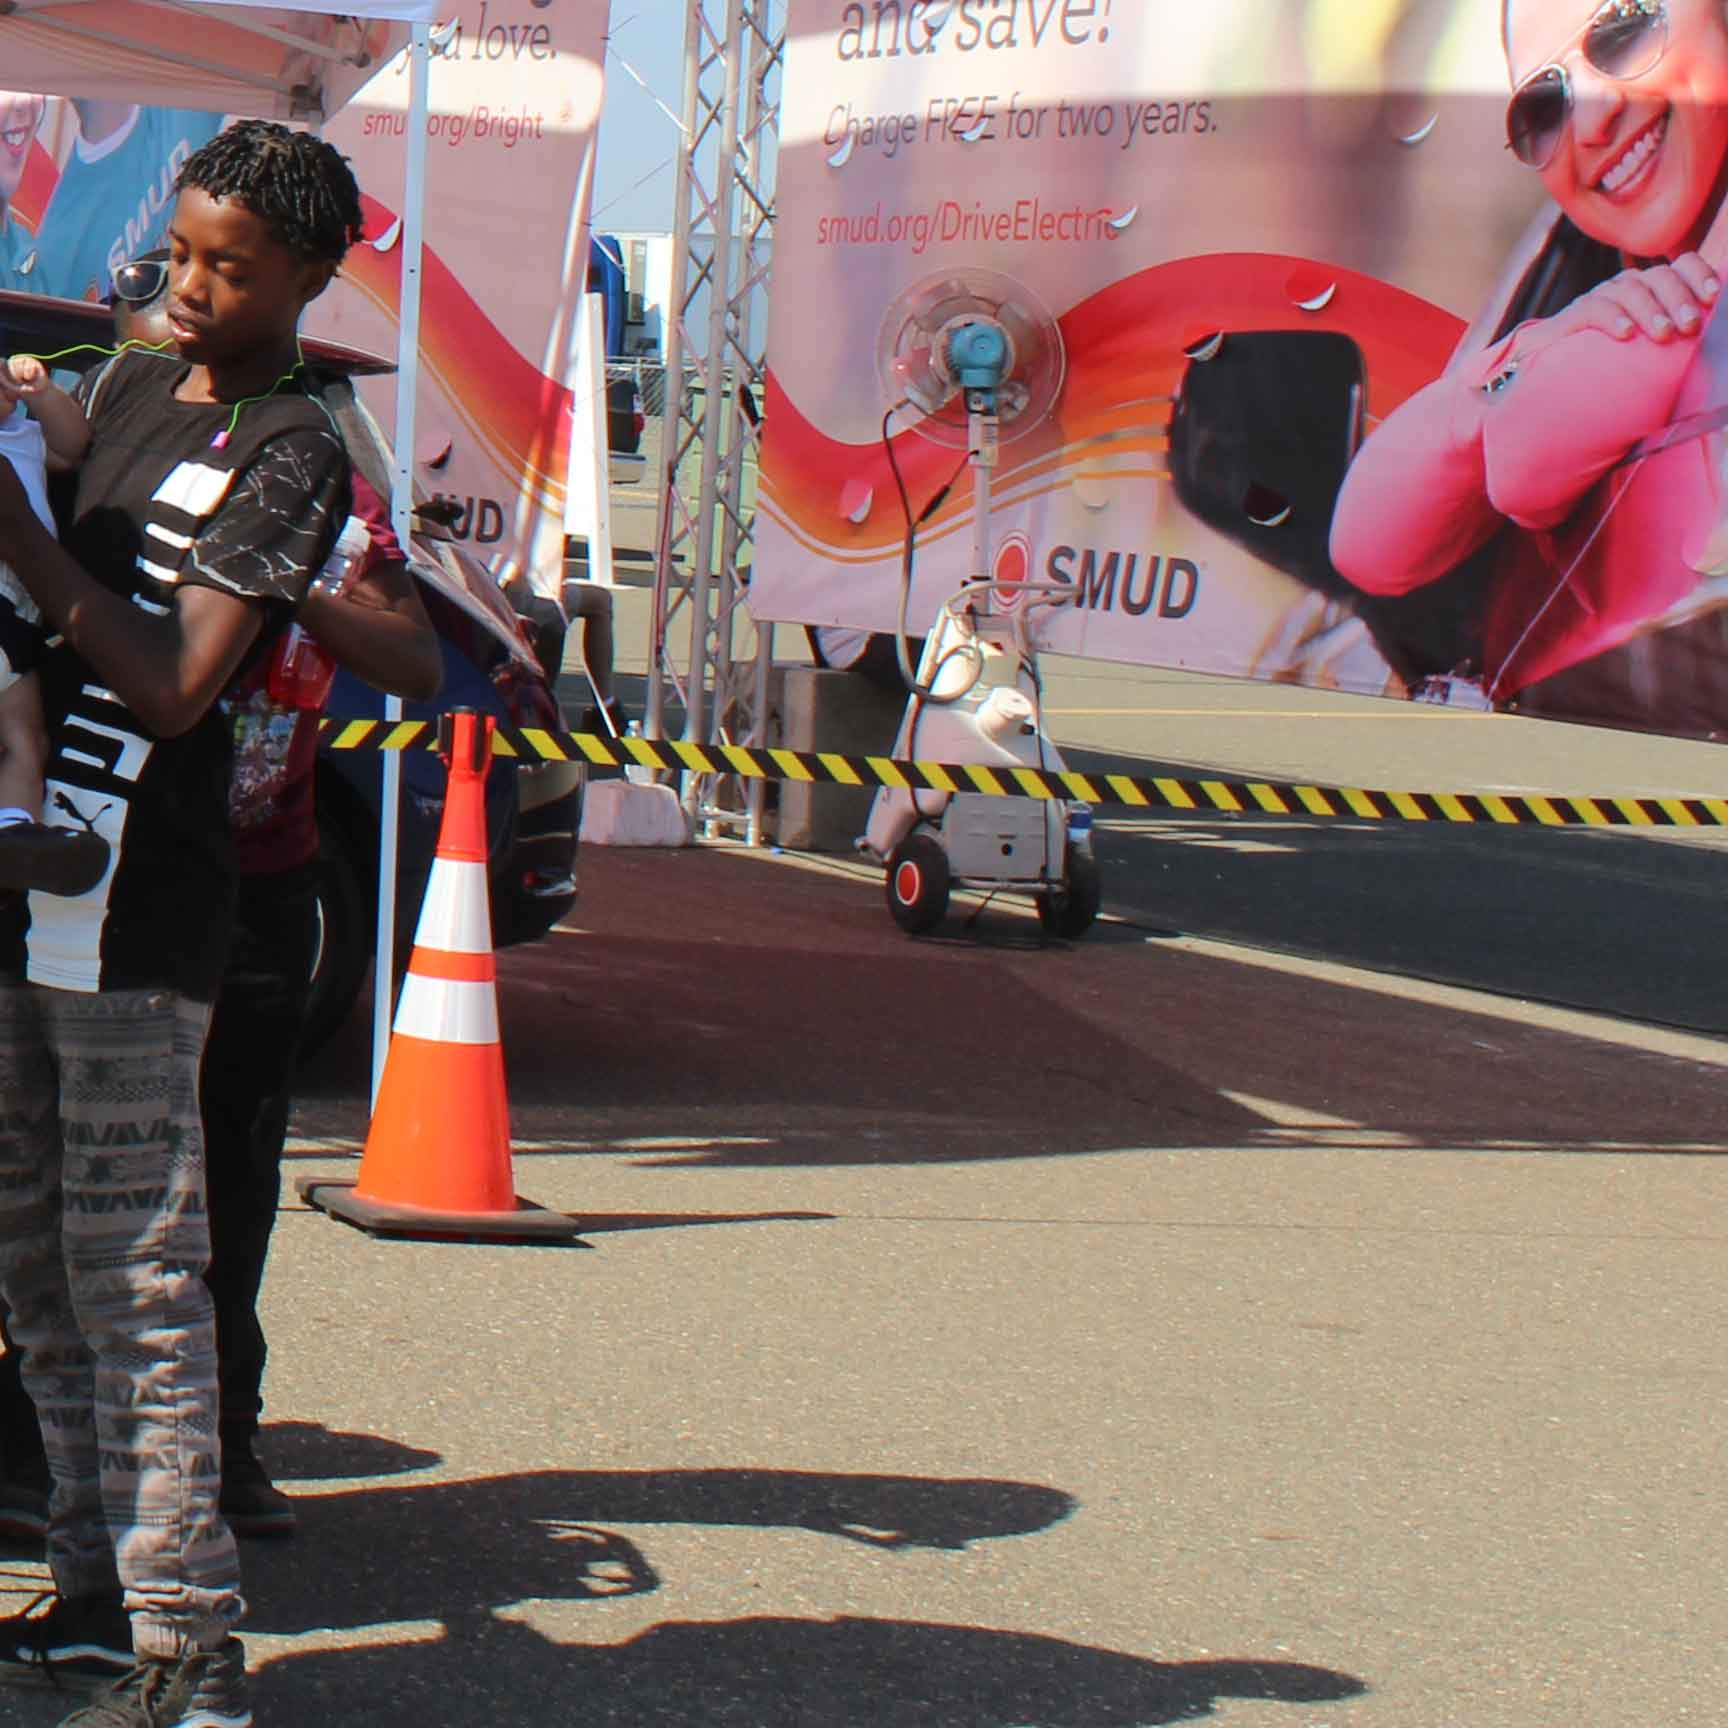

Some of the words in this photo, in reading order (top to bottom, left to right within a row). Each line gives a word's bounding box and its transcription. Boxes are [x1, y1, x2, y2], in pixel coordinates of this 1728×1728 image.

[475, 1, 557, 61] love.
[824, 103, 917, 158] Charge
[1007, 91, 1048, 139] for
[1056, 101, 1113, 138] two
[1125, 97, 1218, 149] years.
[1047, 545, 1198, 619] SMUD
